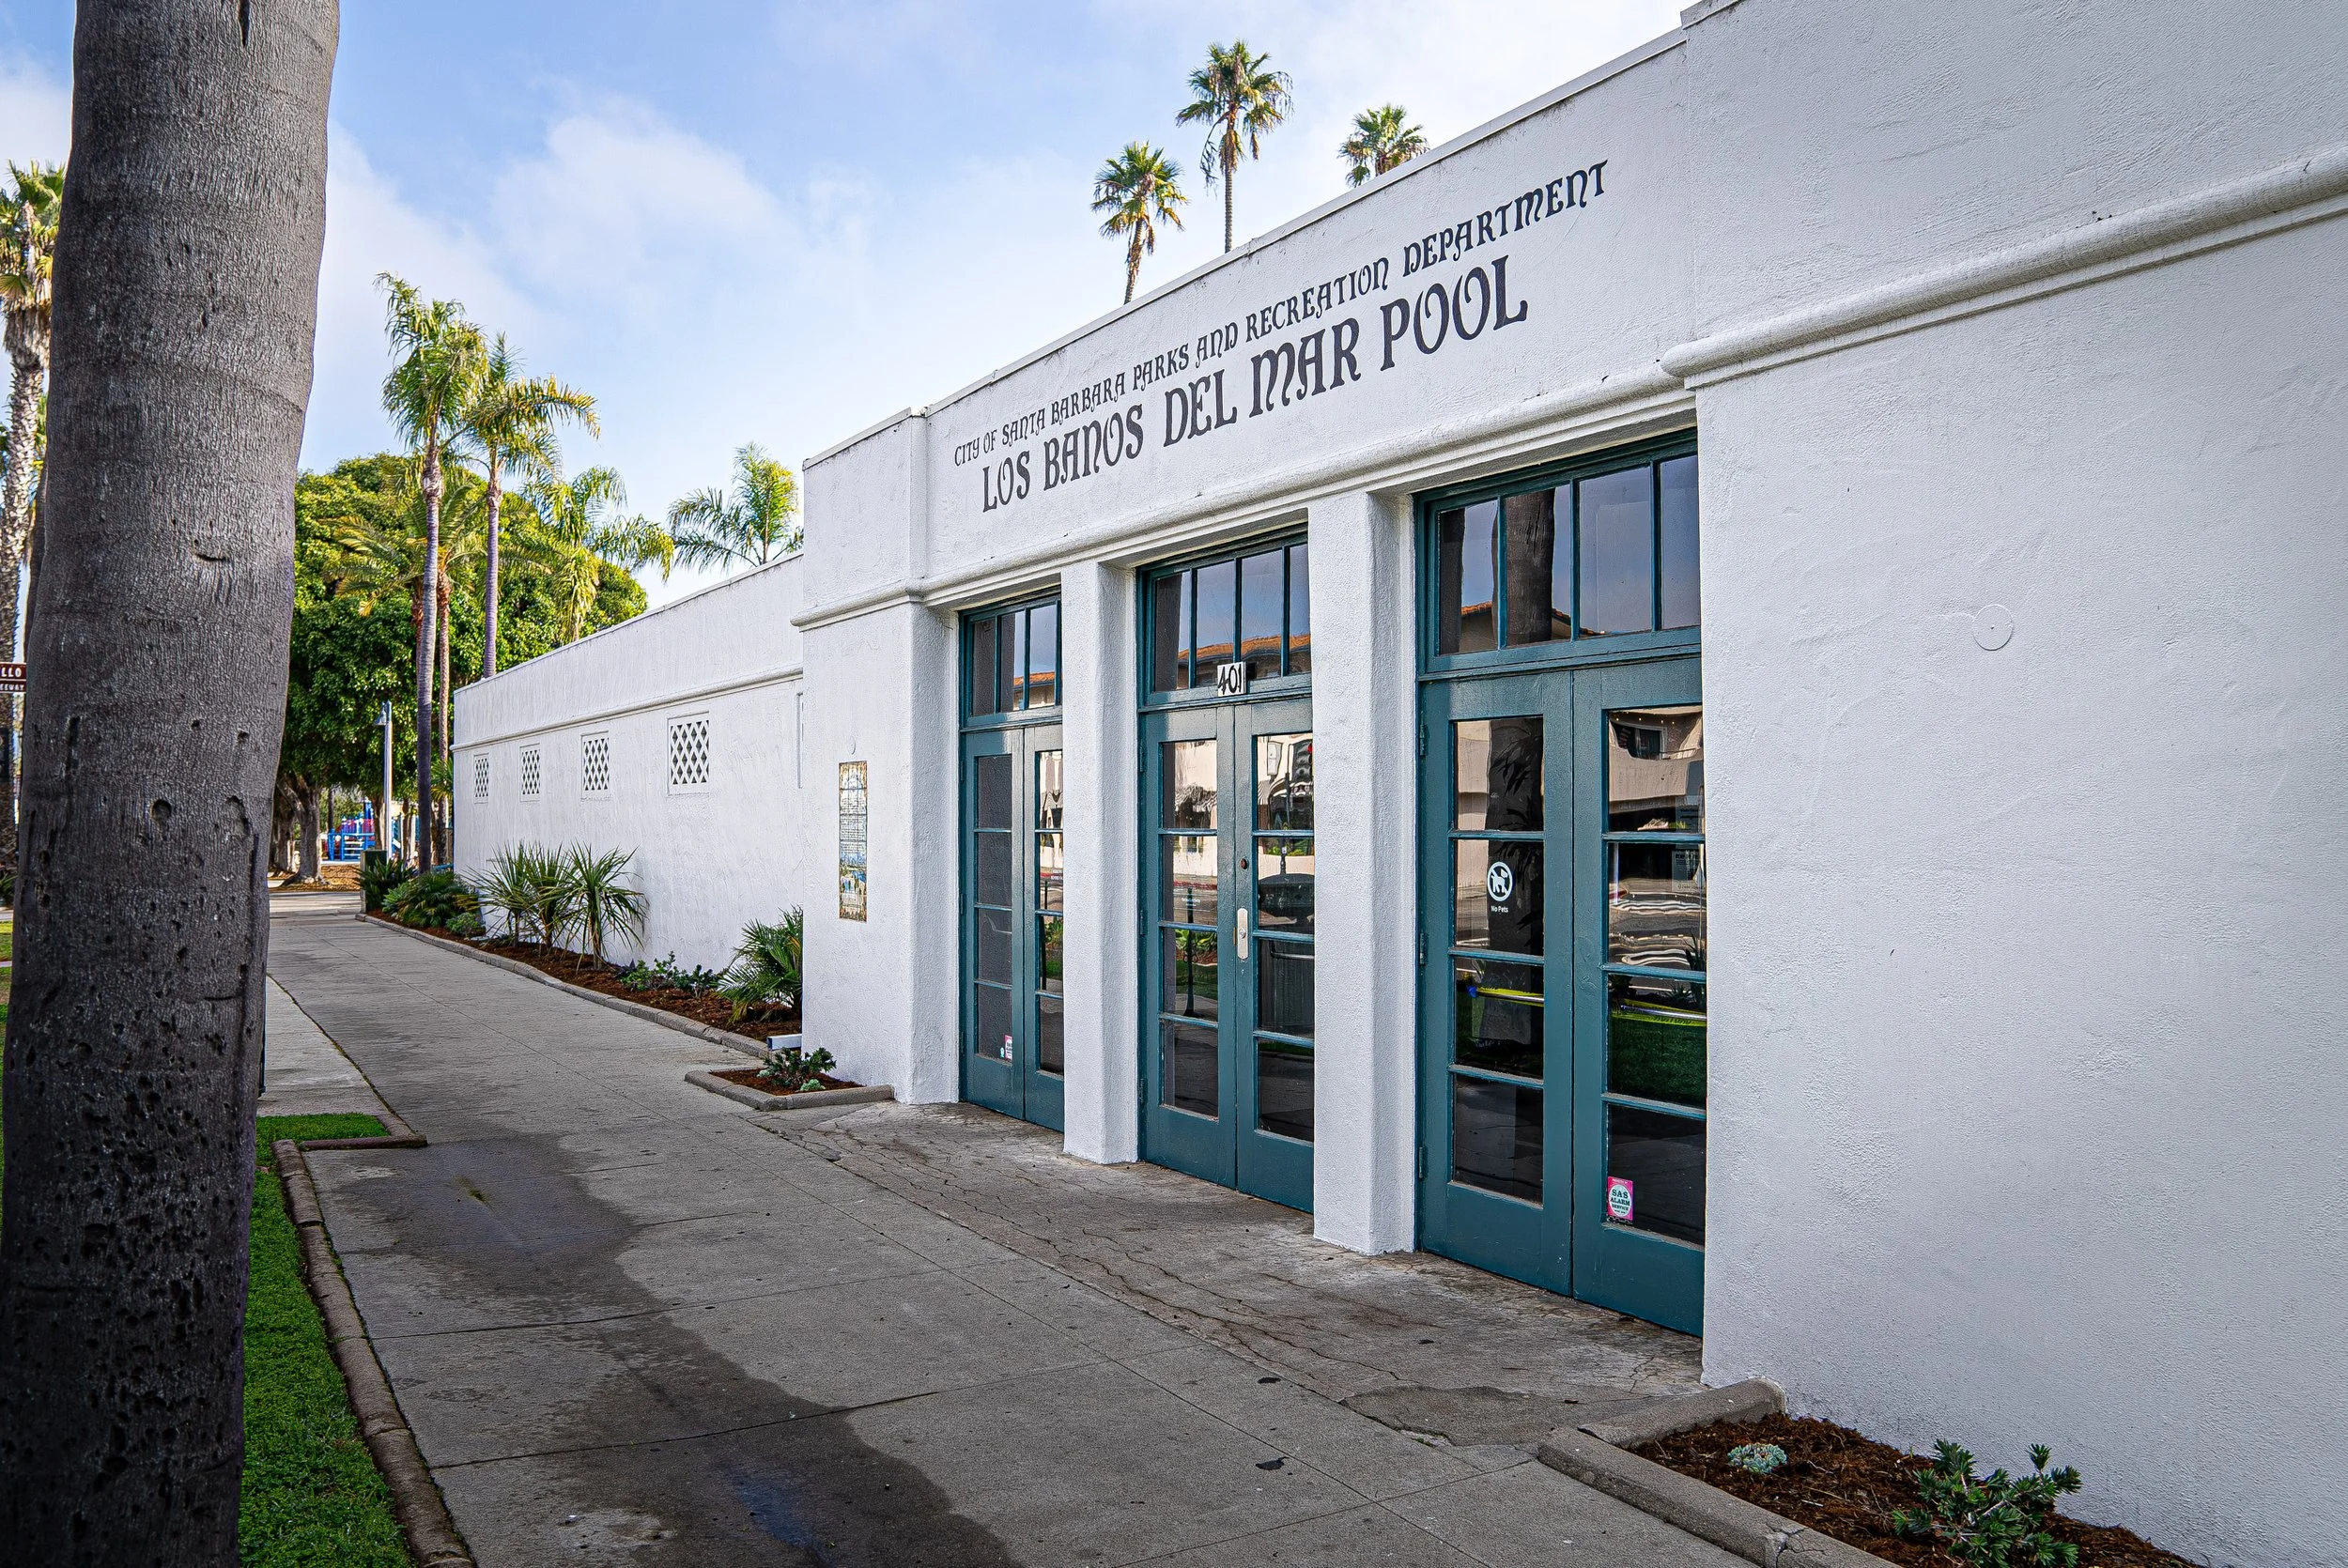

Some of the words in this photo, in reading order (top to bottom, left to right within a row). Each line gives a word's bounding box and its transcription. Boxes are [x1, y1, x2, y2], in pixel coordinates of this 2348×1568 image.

[954, 438, 981, 467] CITY
[982, 429, 997, 453] OF
[1002, 408, 1045, 446] SANTA
[1051, 372, 1125, 425] BARBARA
[1133, 343, 1189, 392] PARKS
[1195, 322, 1239, 369] AND
[1246, 257, 1390, 343] RECREATION
[1402, 160, 1609, 278] DEPARTMENT
[982, 451, 1031, 514] LOS
[1043, 404, 1144, 492] BANOS
[1164, 369, 1238, 448] DEL
[1249, 317, 1362, 419] MAR
[1380, 254, 1529, 372] POOL
[1217, 663, 1243, 696] 401
[1498, 905, 1509, 914] Pets
[1612, 1189, 1629, 1199] SAS
